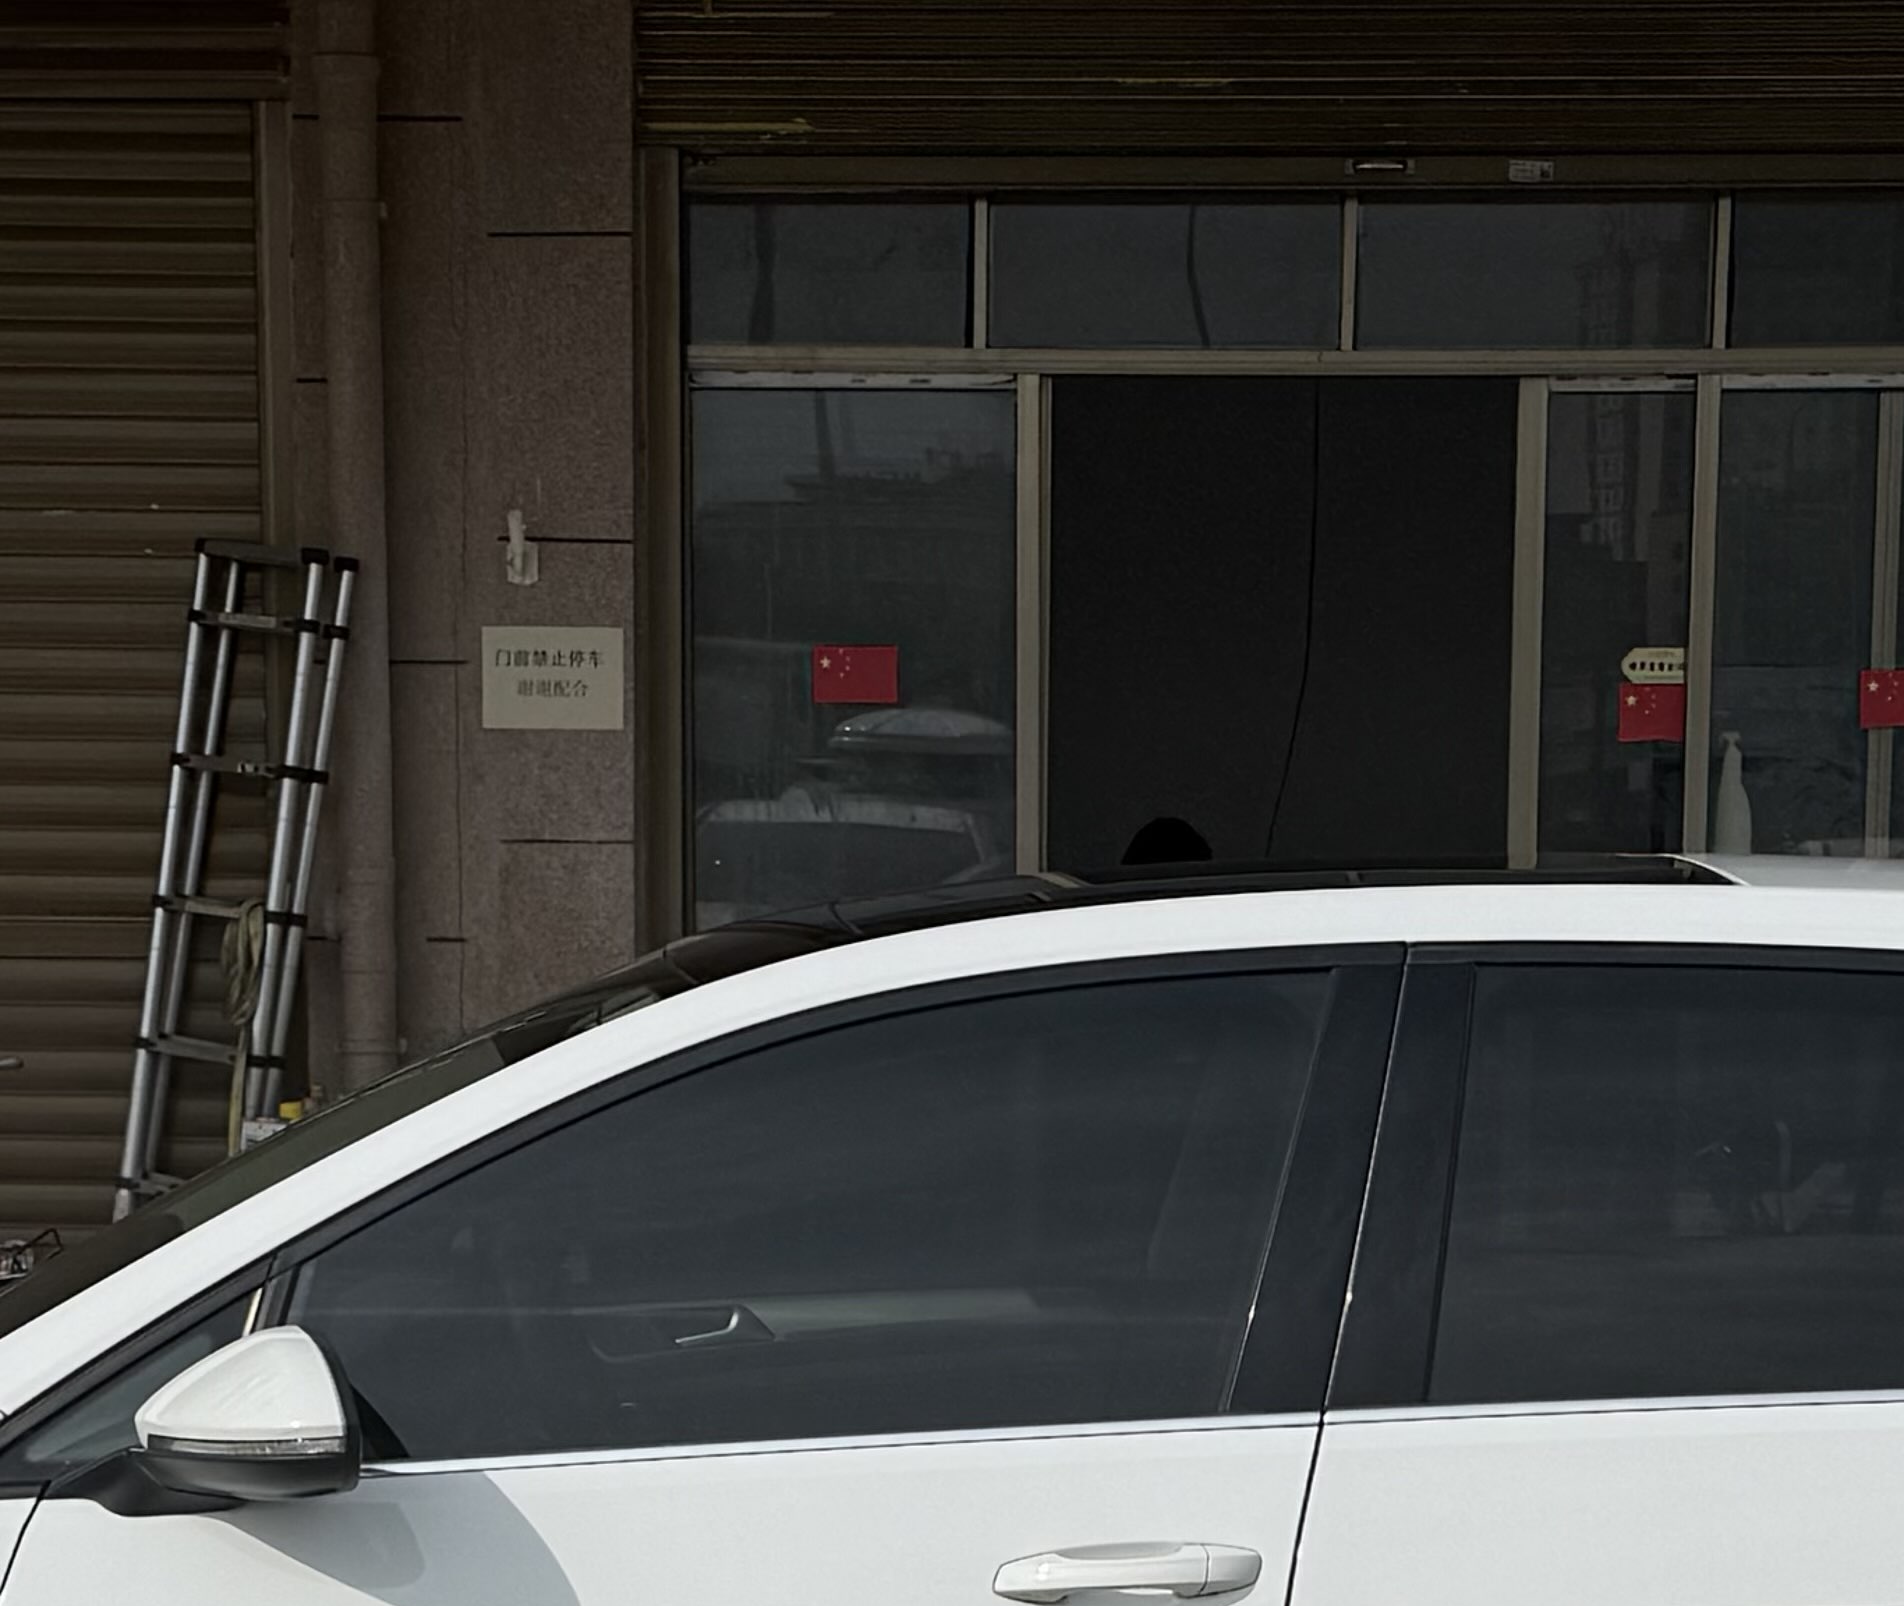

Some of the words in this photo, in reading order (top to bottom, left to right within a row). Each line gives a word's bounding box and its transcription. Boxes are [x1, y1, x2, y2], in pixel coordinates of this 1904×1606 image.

[495, 648, 604, 669] 门前禁止停车
[516, 678, 589, 698] 谢谢配合
